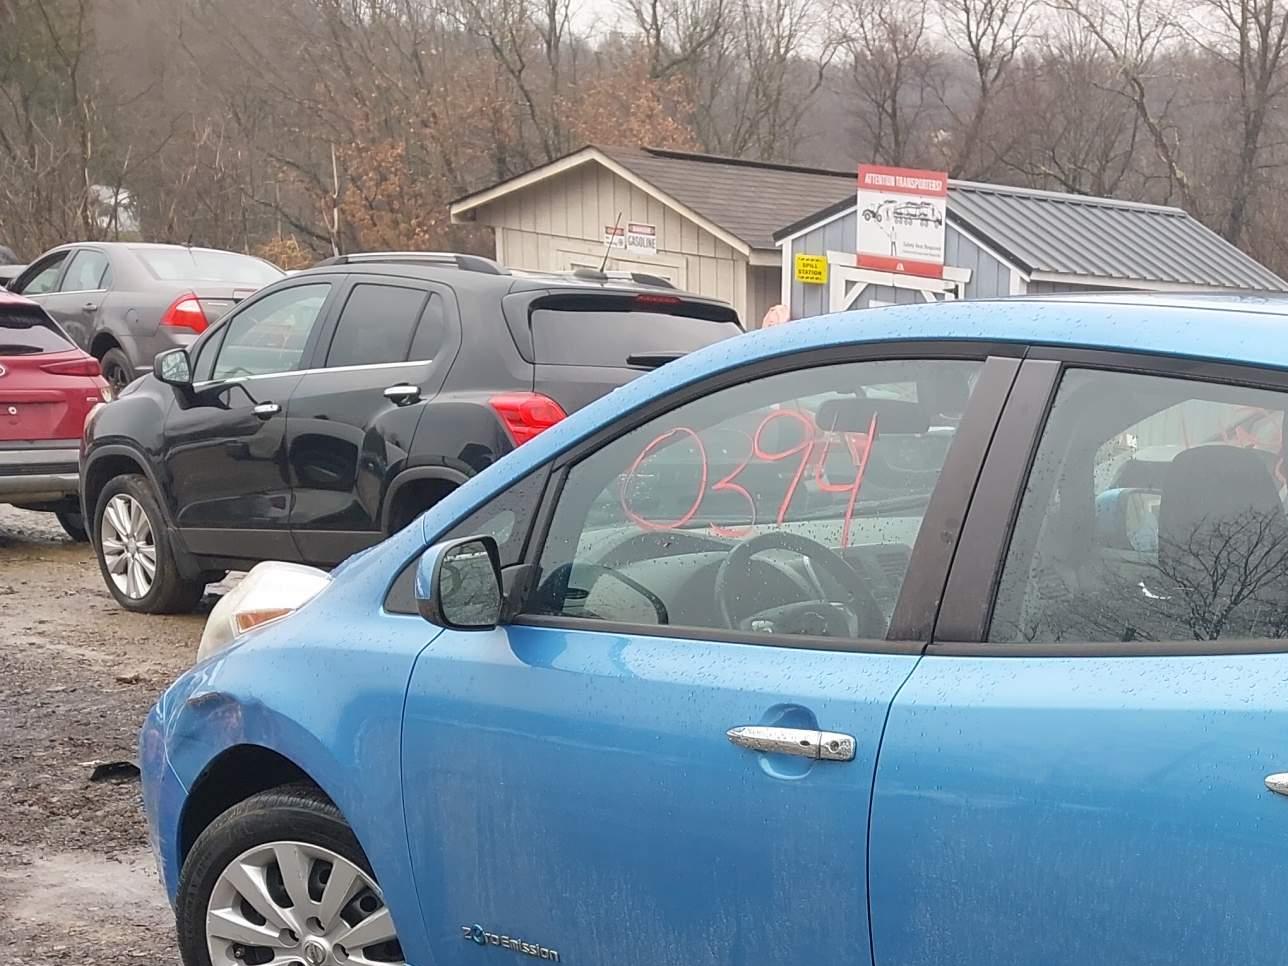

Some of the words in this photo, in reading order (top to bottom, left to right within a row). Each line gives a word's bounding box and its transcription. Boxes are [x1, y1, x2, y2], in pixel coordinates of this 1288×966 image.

[864, 172, 895, 187] ATTENTION
[628, 235, 656, 249] GASOLINE
[620, 408, 878, 550] 0394
